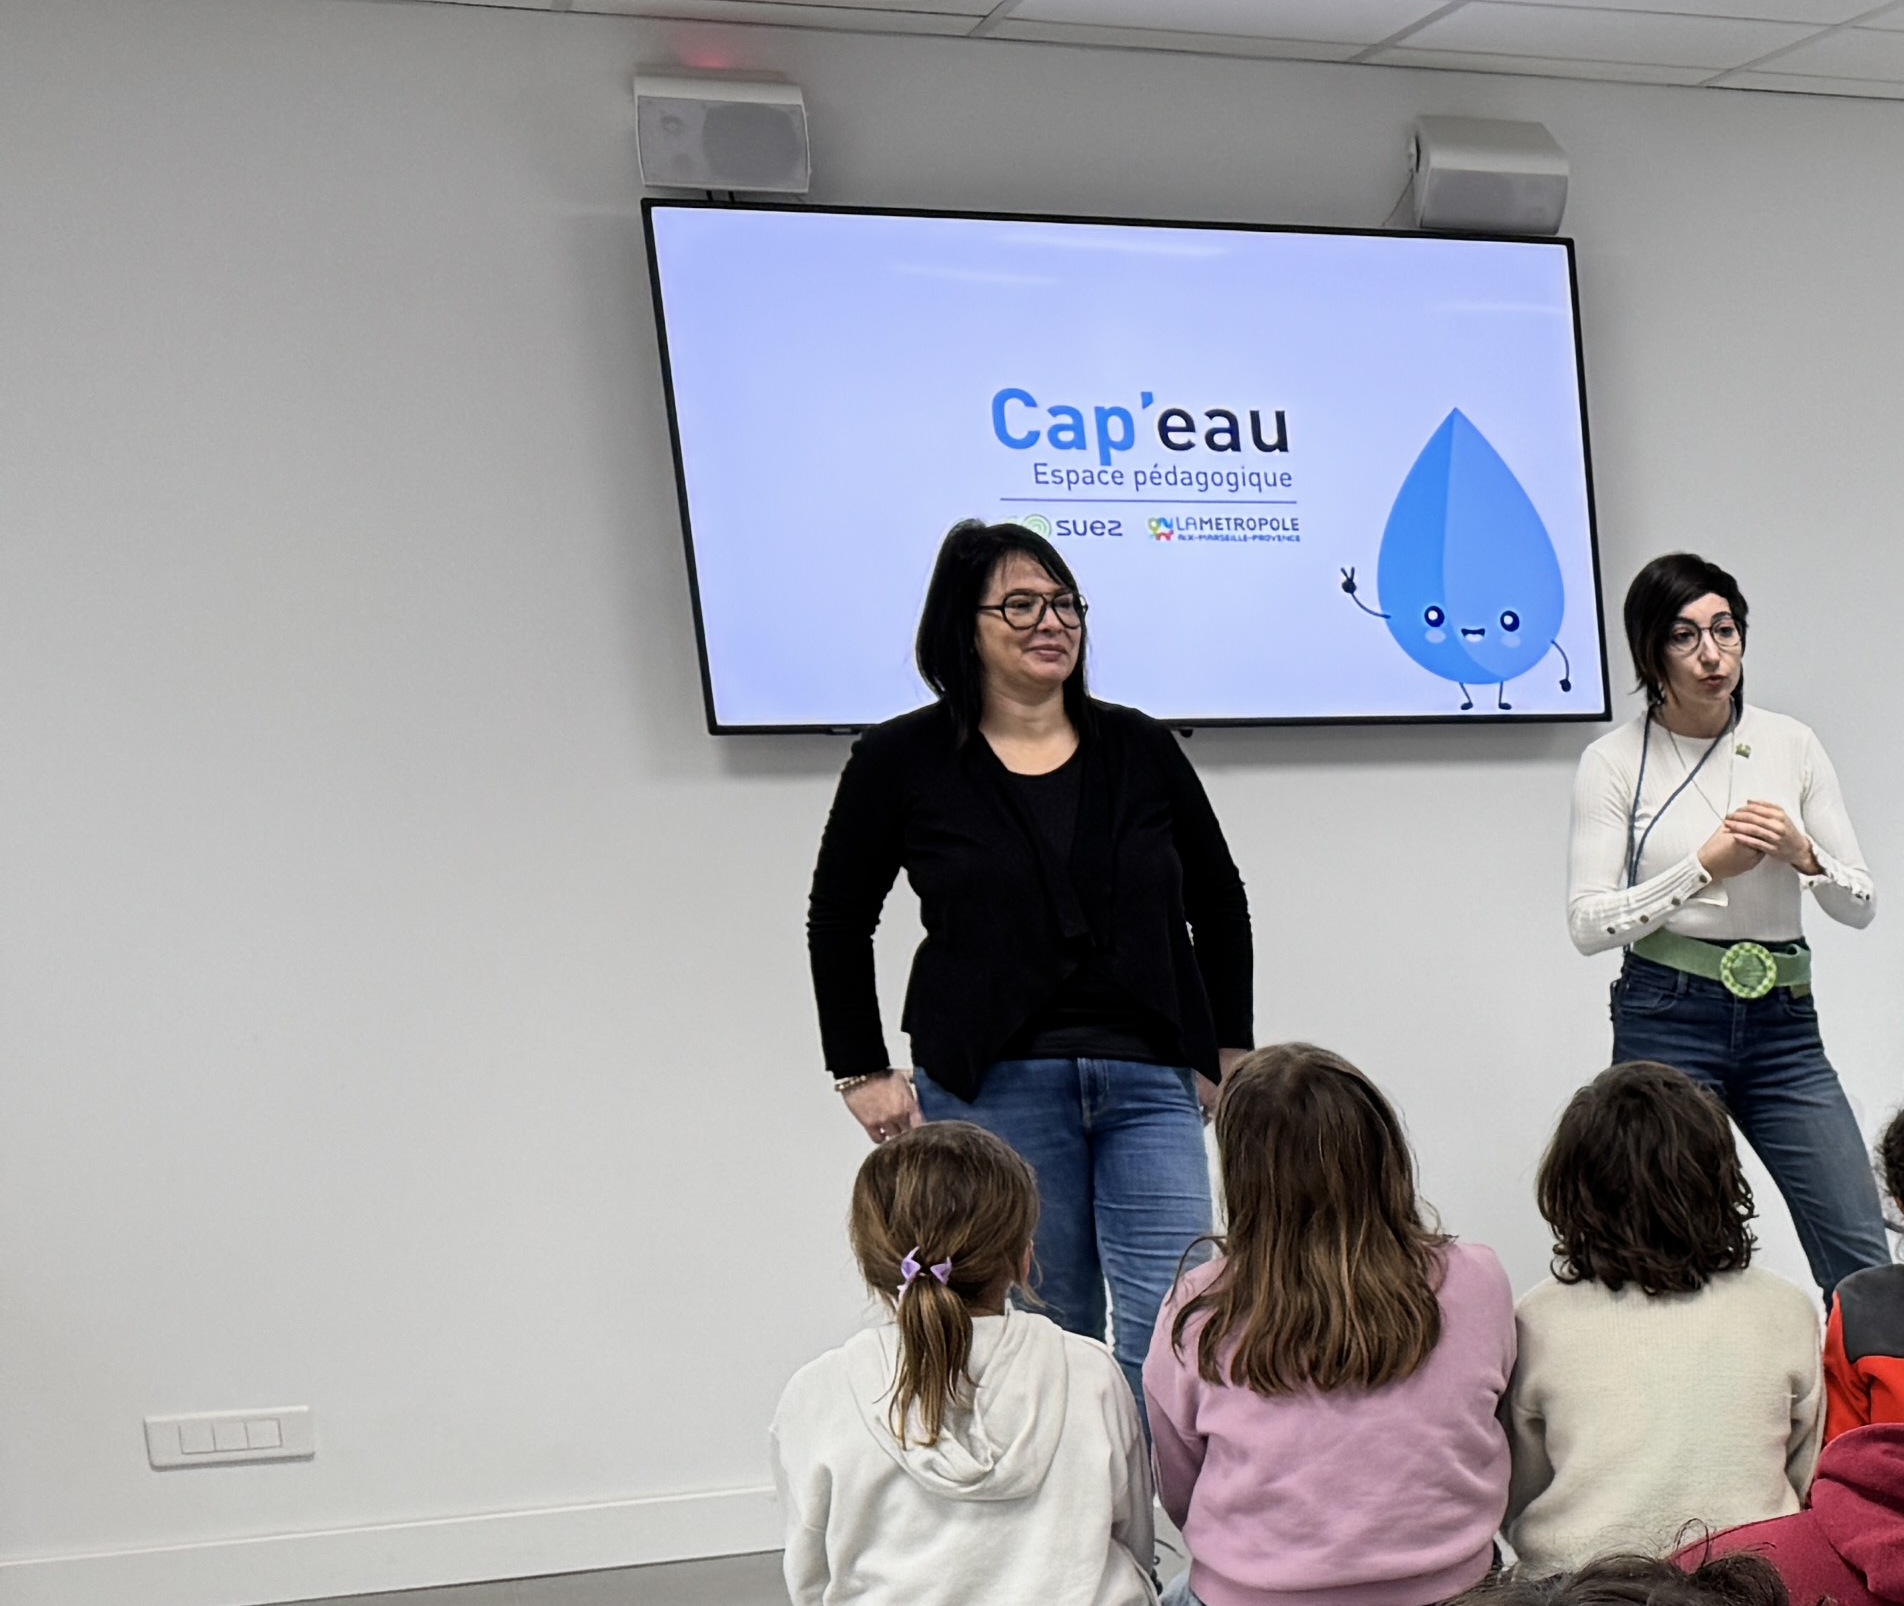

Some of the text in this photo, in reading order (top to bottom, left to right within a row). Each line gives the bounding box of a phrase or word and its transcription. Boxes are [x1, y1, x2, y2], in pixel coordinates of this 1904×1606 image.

[991, 388, 1289, 466] Cap'eau
[1033, 462, 1293, 492] Espace pédagogique
[1056, 519, 1123, 537] suez
